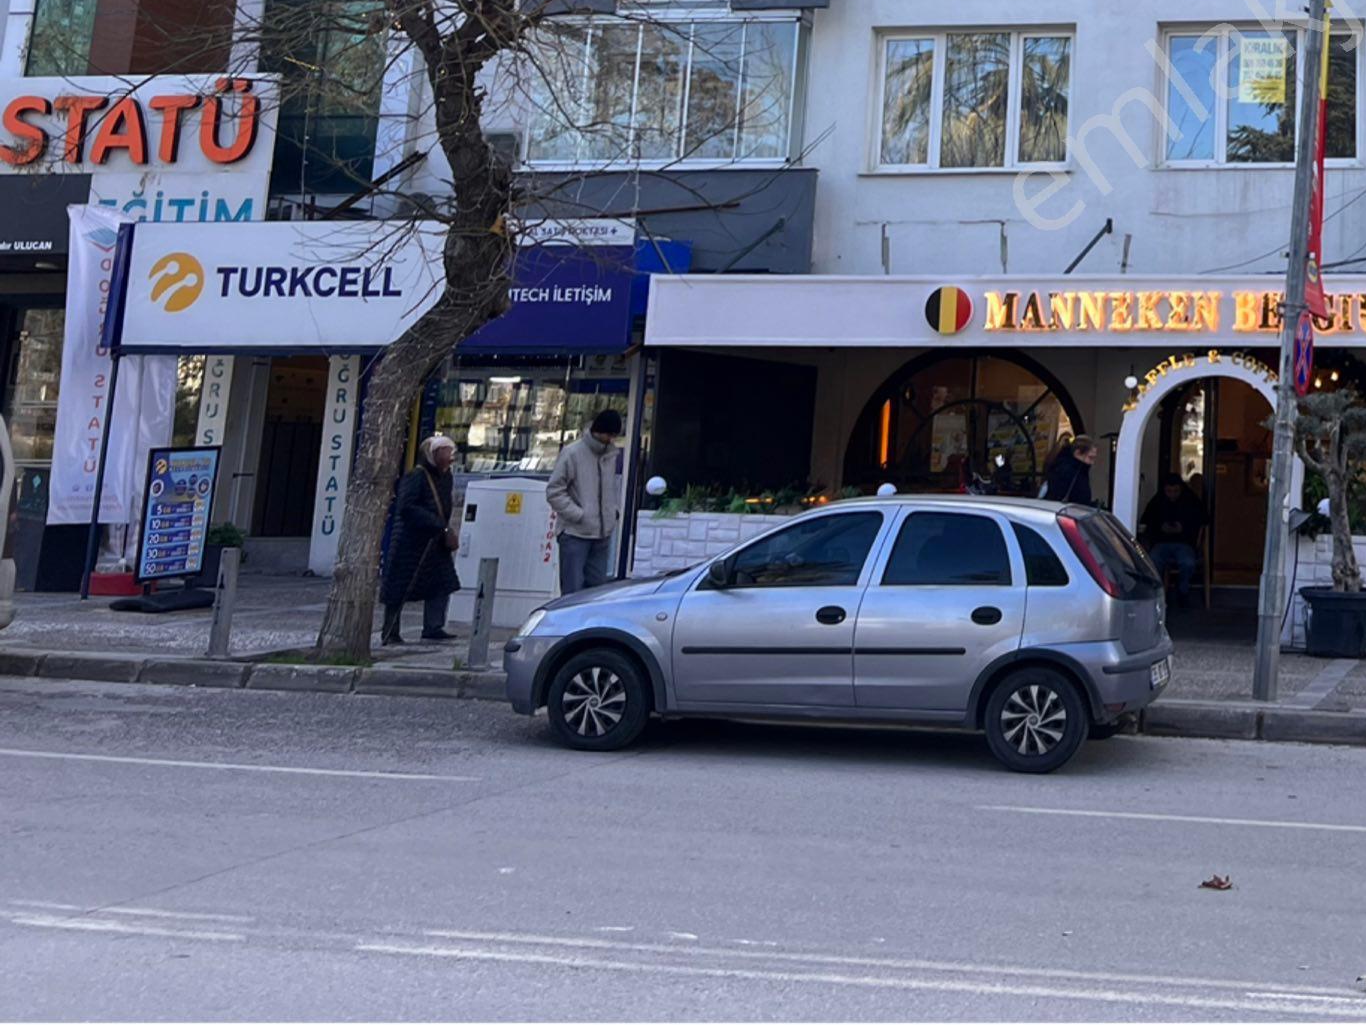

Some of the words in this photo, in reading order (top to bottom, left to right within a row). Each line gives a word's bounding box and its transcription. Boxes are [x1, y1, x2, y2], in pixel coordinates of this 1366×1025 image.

[0, 77, 261, 166] STATÜ
[99, 191, 253, 222] ĞİTİM
[14, 240, 52, 250] ULUCAN
[217, 266, 402, 298] TURKCELL
[508, 288, 549, 302] TECH
[553, 284, 612, 305] İLETİŞİM
[984, 291, 1221, 332] MANNEKEN
[1207, 349, 1221, 365] &
[1231, 351, 1280, 383] COFF
